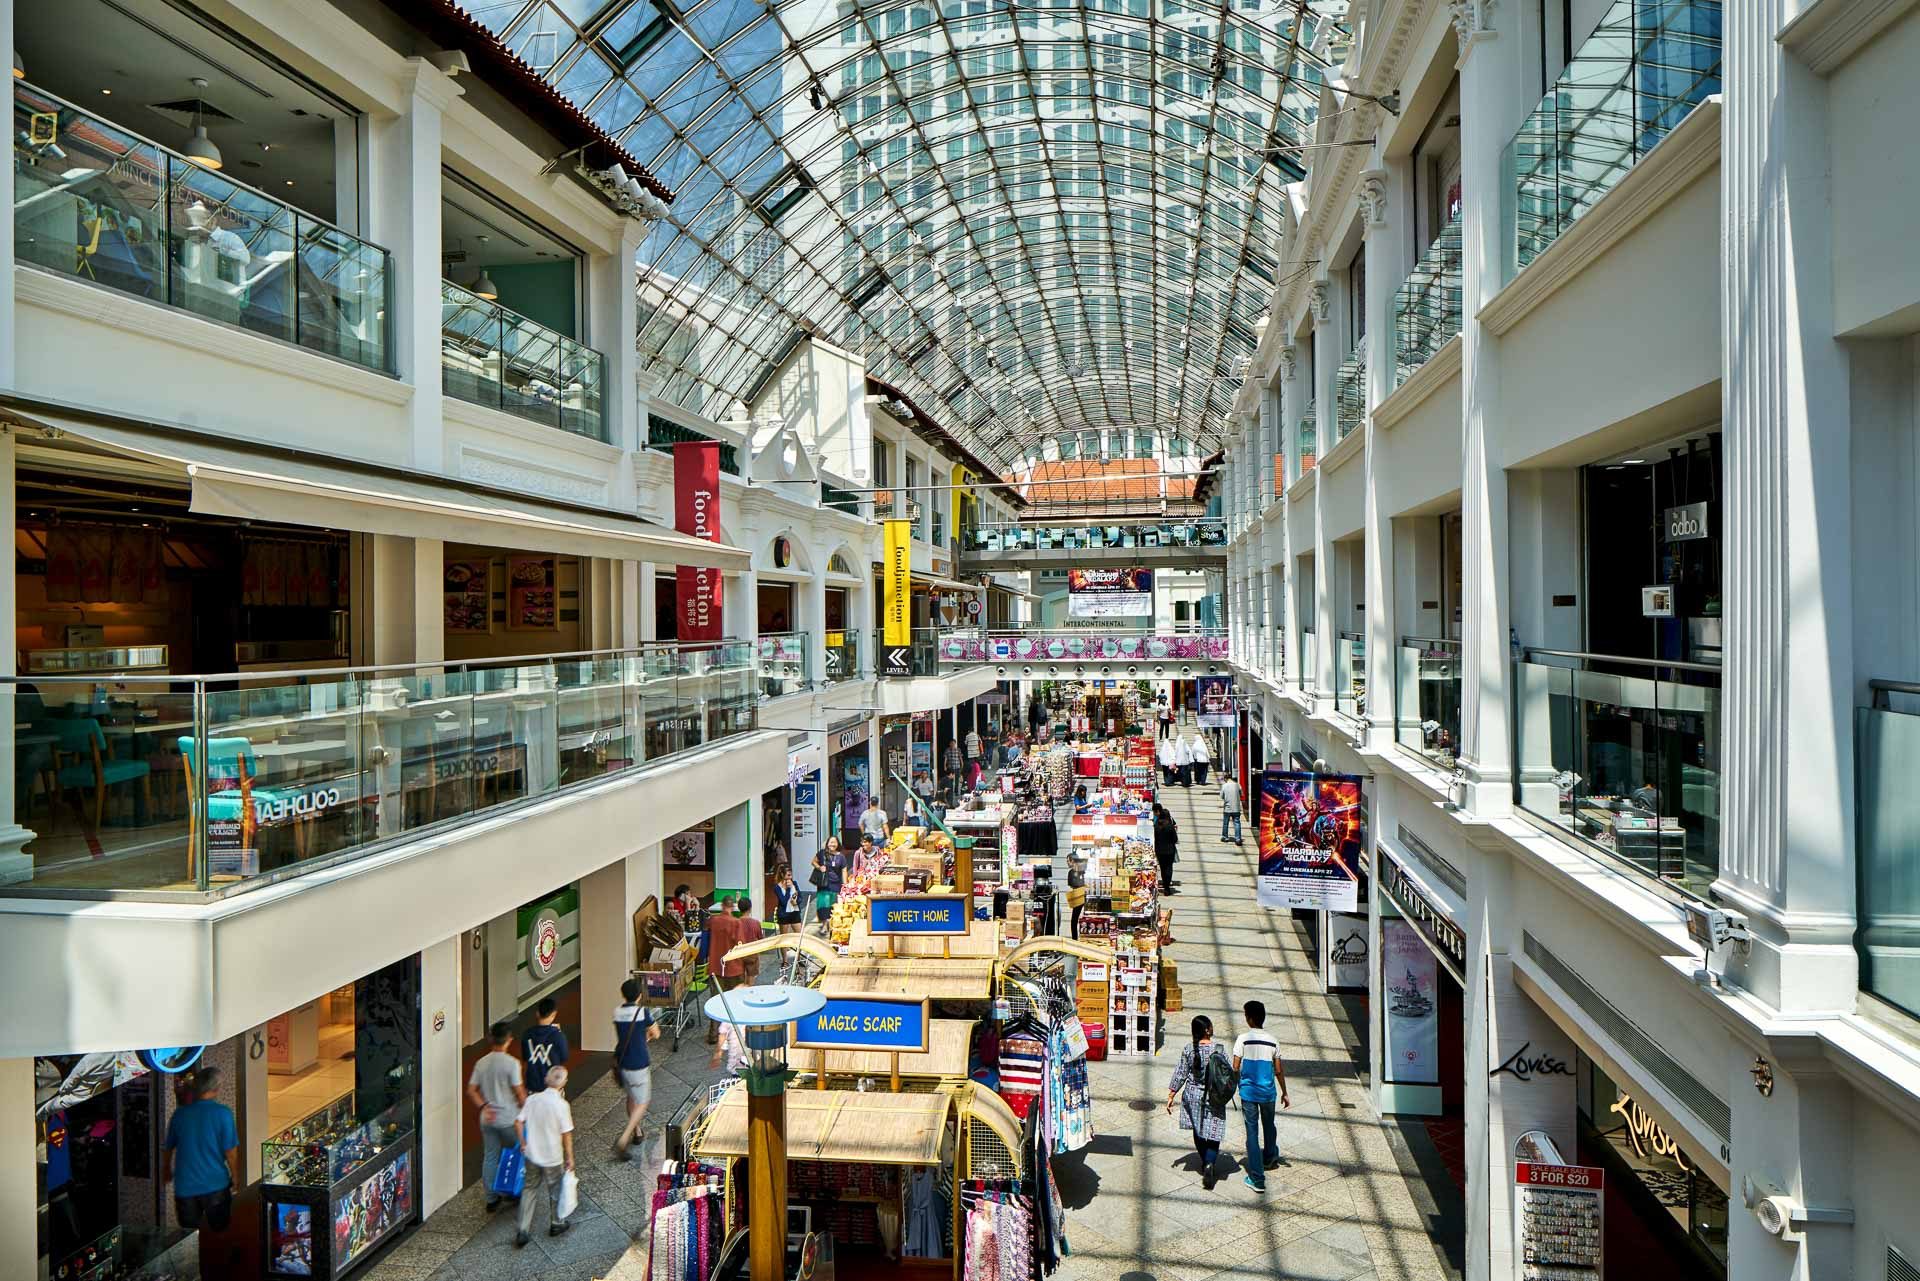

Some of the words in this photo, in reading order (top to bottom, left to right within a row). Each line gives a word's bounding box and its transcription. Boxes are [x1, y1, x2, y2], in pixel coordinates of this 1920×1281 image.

[1671, 511, 1698, 537] odbo
[895, 546, 906, 623] foodjunction
[969, 603, 978, 611] 50
[1282, 847, 1332, 857] GUARDIANS
[1293, 854, 1330, 863] GALAXY
[887, 910, 919, 923] SWEET
[923, 909, 950, 923] HOME
[1399, 878, 1425, 920] VENUS
[1430, 911, 1462, 960] TEARS
[817, 1015, 858, 1032] MAGIC
[863, 1016, 903, 1033] SCARF
[1489, 1041, 1576, 1081] Lovisa
[1550, 1166, 1569, 1174] SALE
[1530, 1171, 1538, 1182] 3
[1541, 1171, 1564, 1183] FOR
[1567, 1174, 1589, 1185] $20
